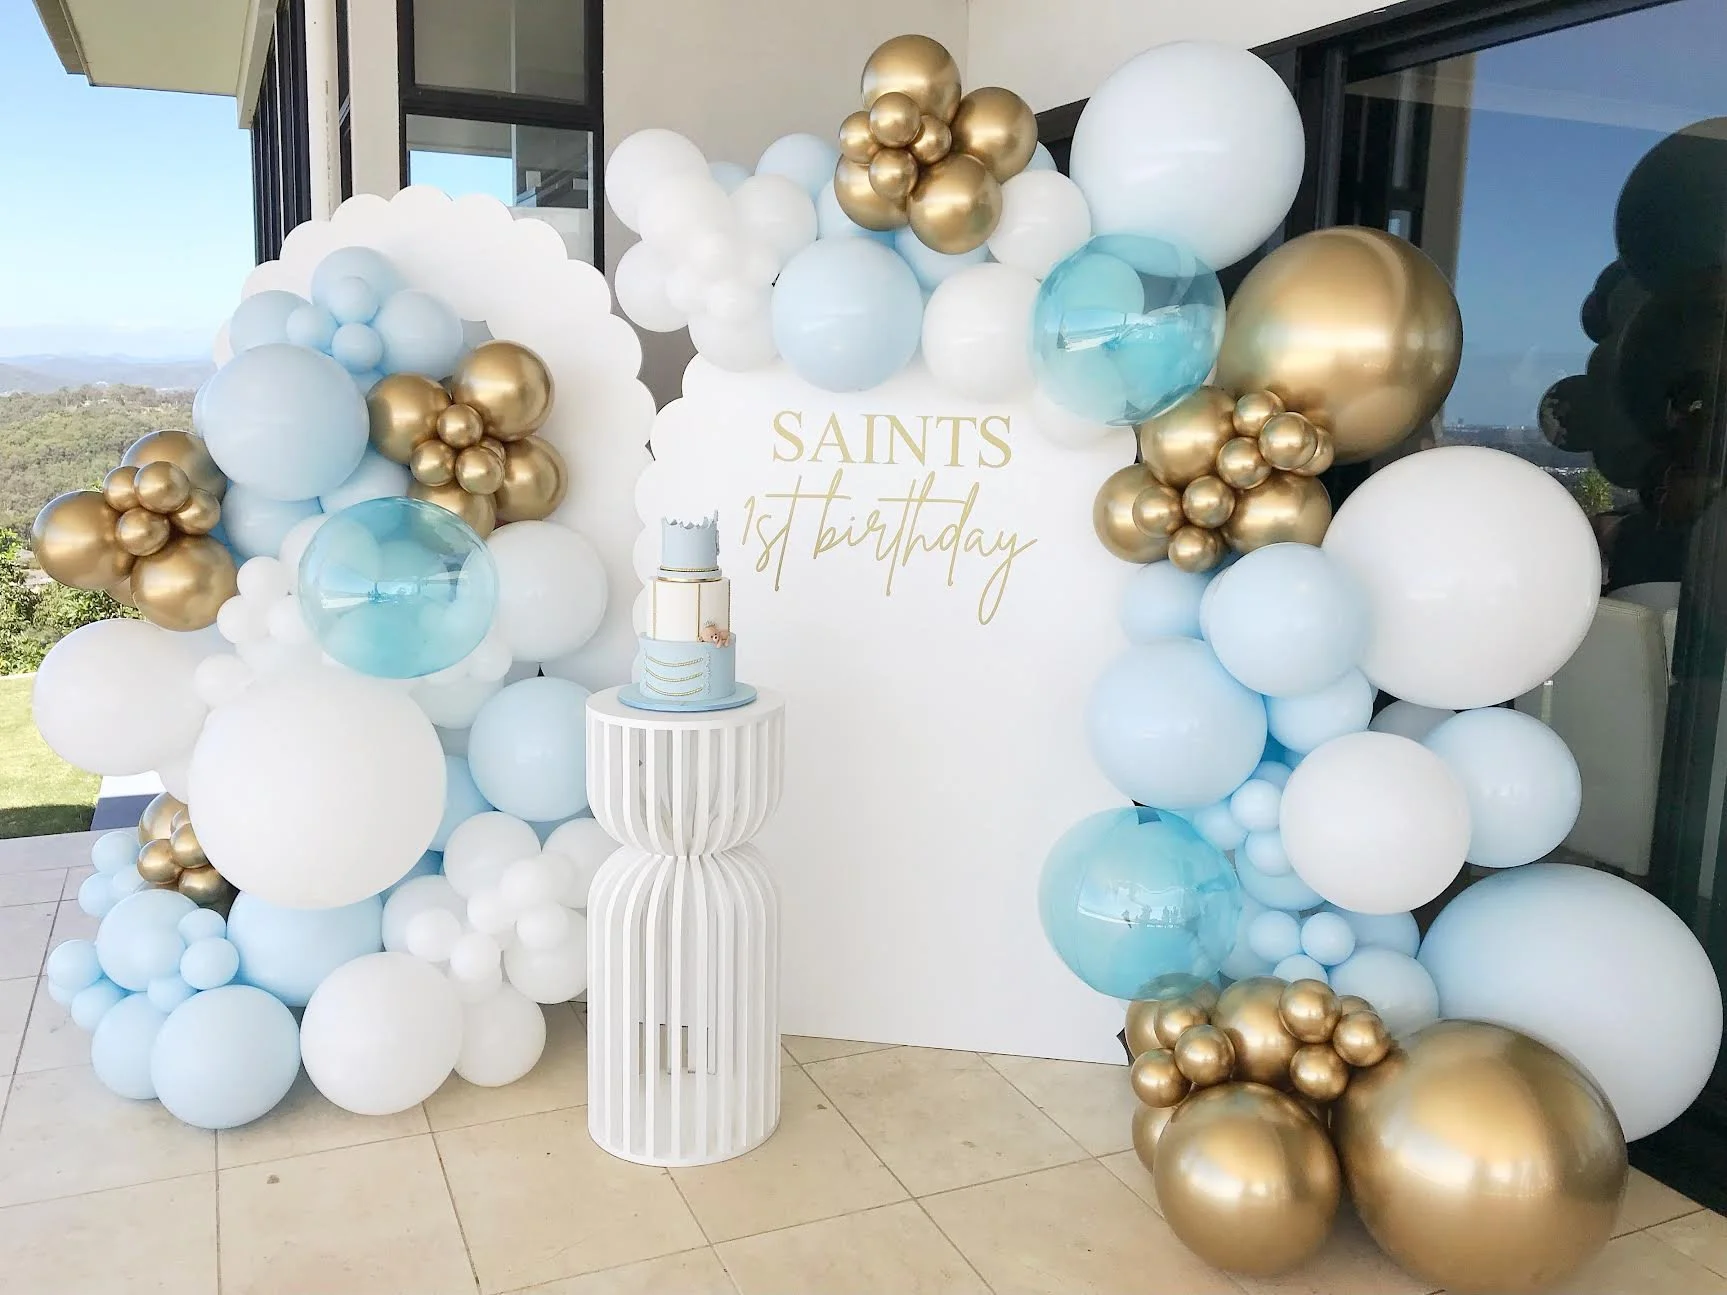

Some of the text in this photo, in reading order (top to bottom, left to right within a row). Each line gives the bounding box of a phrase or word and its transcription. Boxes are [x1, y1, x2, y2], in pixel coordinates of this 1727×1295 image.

[772, 410, 1012, 468] SAINTS
[742, 468, 1038, 625] 1st birthday
